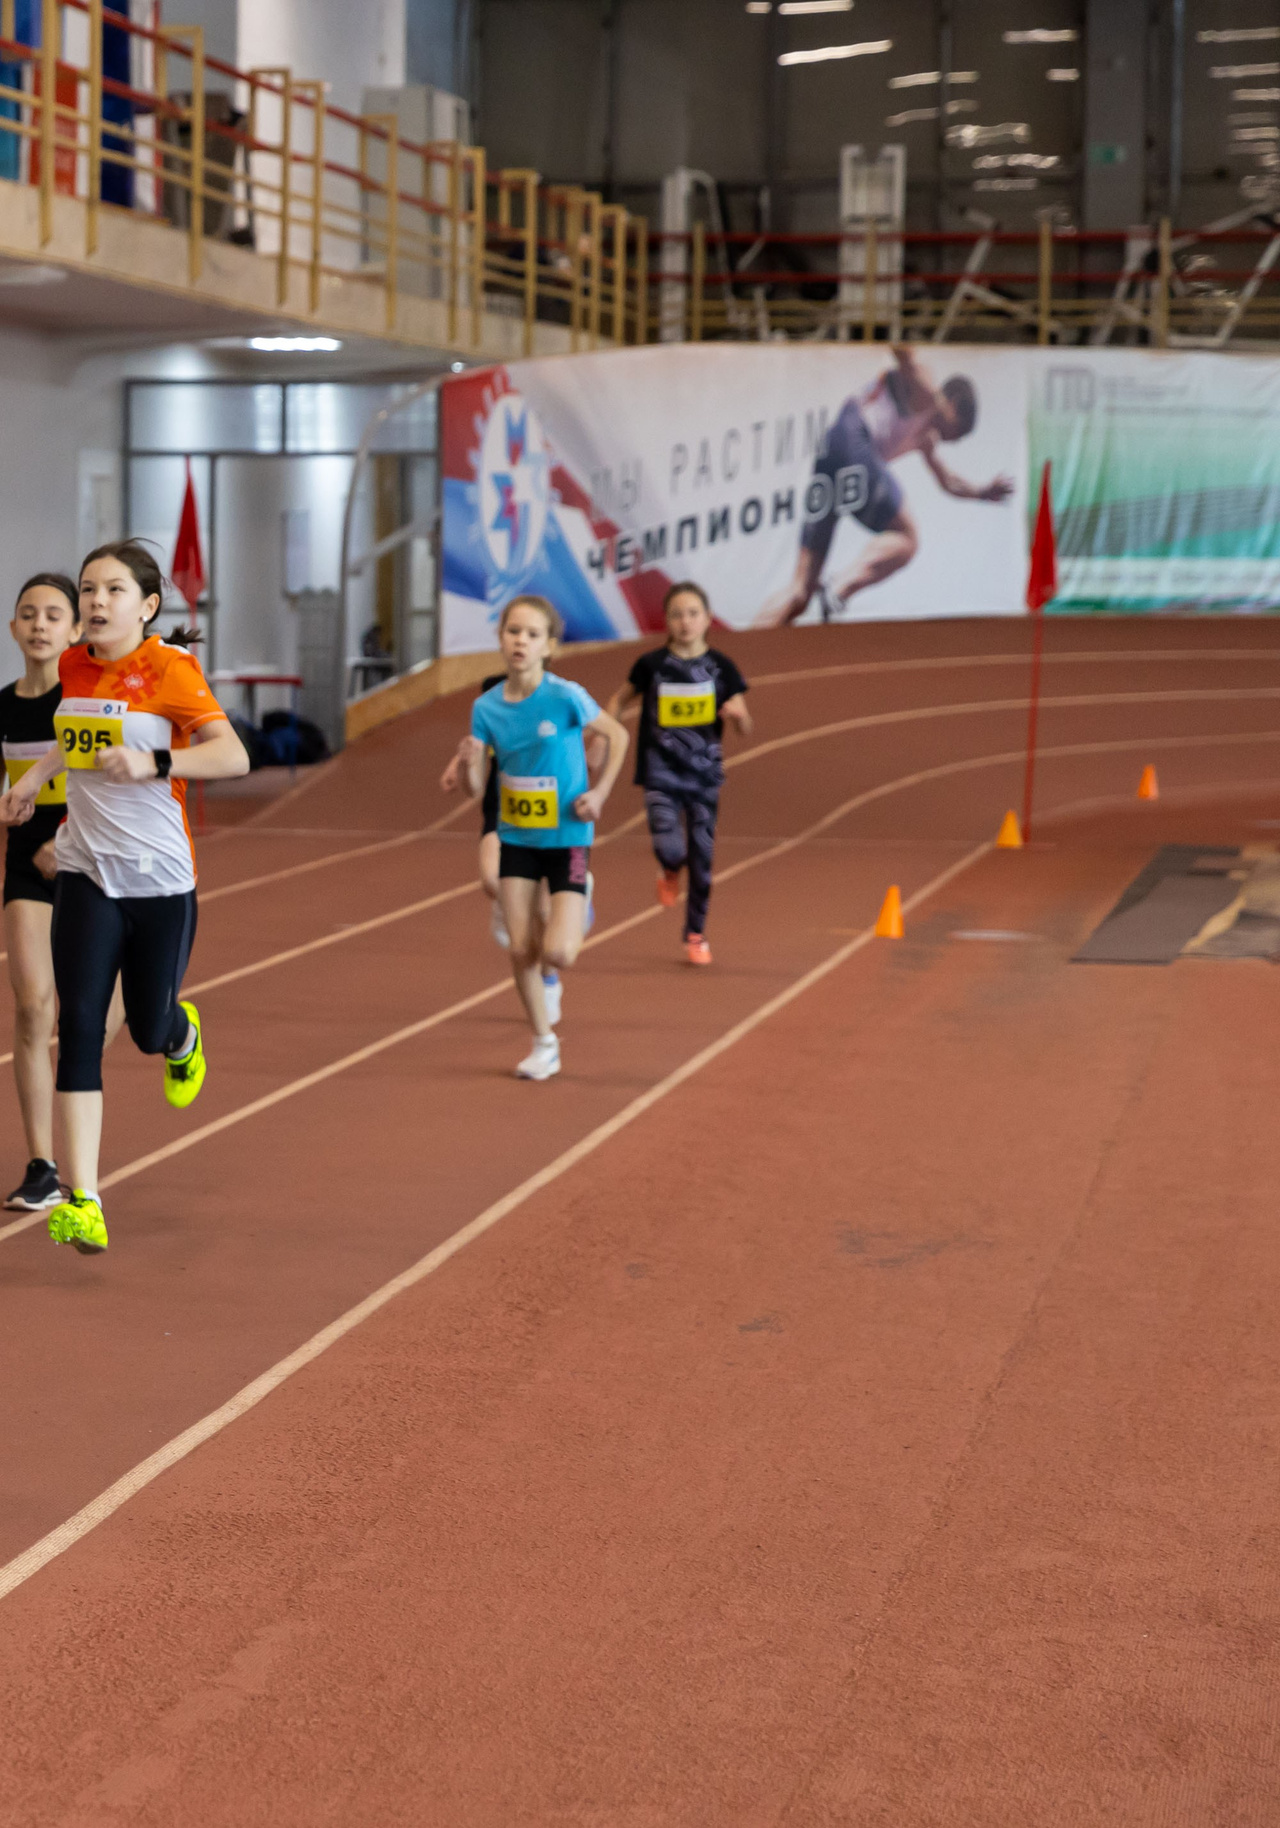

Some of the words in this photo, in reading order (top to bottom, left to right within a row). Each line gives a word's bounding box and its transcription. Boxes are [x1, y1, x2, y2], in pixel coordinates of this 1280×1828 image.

[671, 406, 829, 493] РАСТИМ
[587, 469, 864, 579] ЧЕМПИОНОВ
[62, 727, 113, 753] 995
